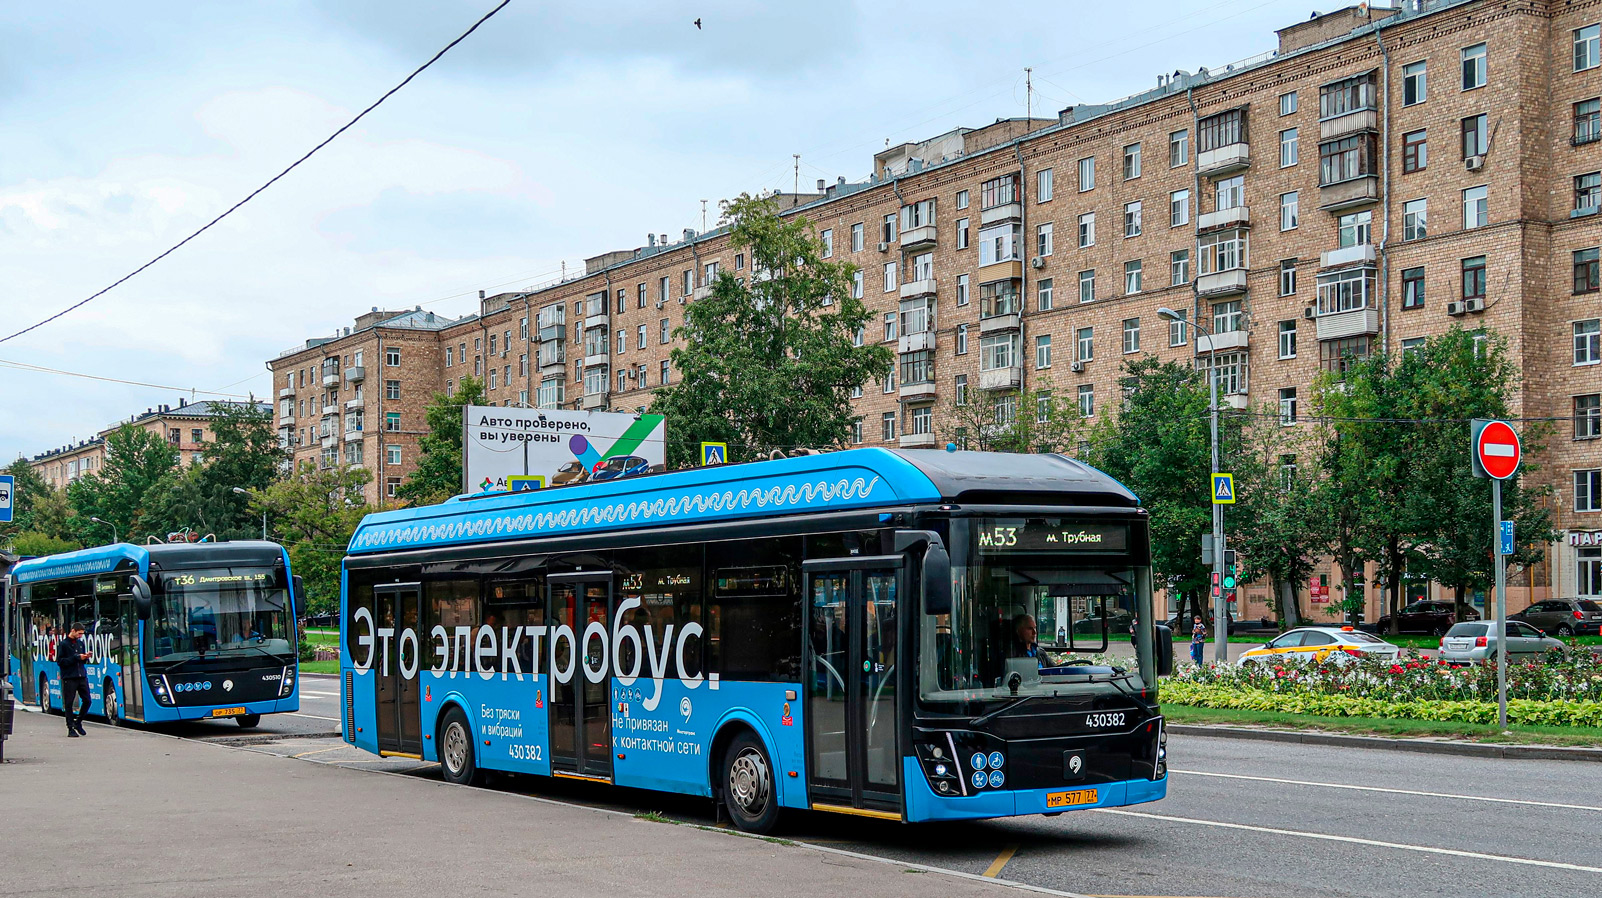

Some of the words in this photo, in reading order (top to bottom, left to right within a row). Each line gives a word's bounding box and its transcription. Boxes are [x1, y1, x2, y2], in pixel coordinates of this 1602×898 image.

[480, 415, 512, 427] Авто
[515, 419, 591, 432] проверено,
[480, 432, 498, 440] вы
[501, 432, 560, 443] уверены
[978, 527, 1017, 546] м53
[1046, 533, 1059, 542] м.
[1062, 530, 1102, 544] Трубная
[175, 575, 195, 585] т36
[199, 575, 242, 583] Дмитровское
[622, 573, 643, 590] м53
[666, 573, 691, 586] Трубная
[32, 624, 50, 662] Это
[353, 606, 419, 680] Это
[430, 596, 720, 712] электробус.
[481, 703, 494, 718] Без
[495, 708, 520, 723] тряски
[1085, 712, 1126, 728] 430382
[481, 724, 487, 735] и
[488, 722, 523, 740] вибраций
[612, 712, 624, 729] Не
[625, 717, 669, 733] привязан
[612, 736, 618, 748] к
[620, 736, 675, 753] контактной
[677, 741, 701, 756] сети
[1065, 792, 1082, 804] 577
[1086, 790, 1095, 800] 77
